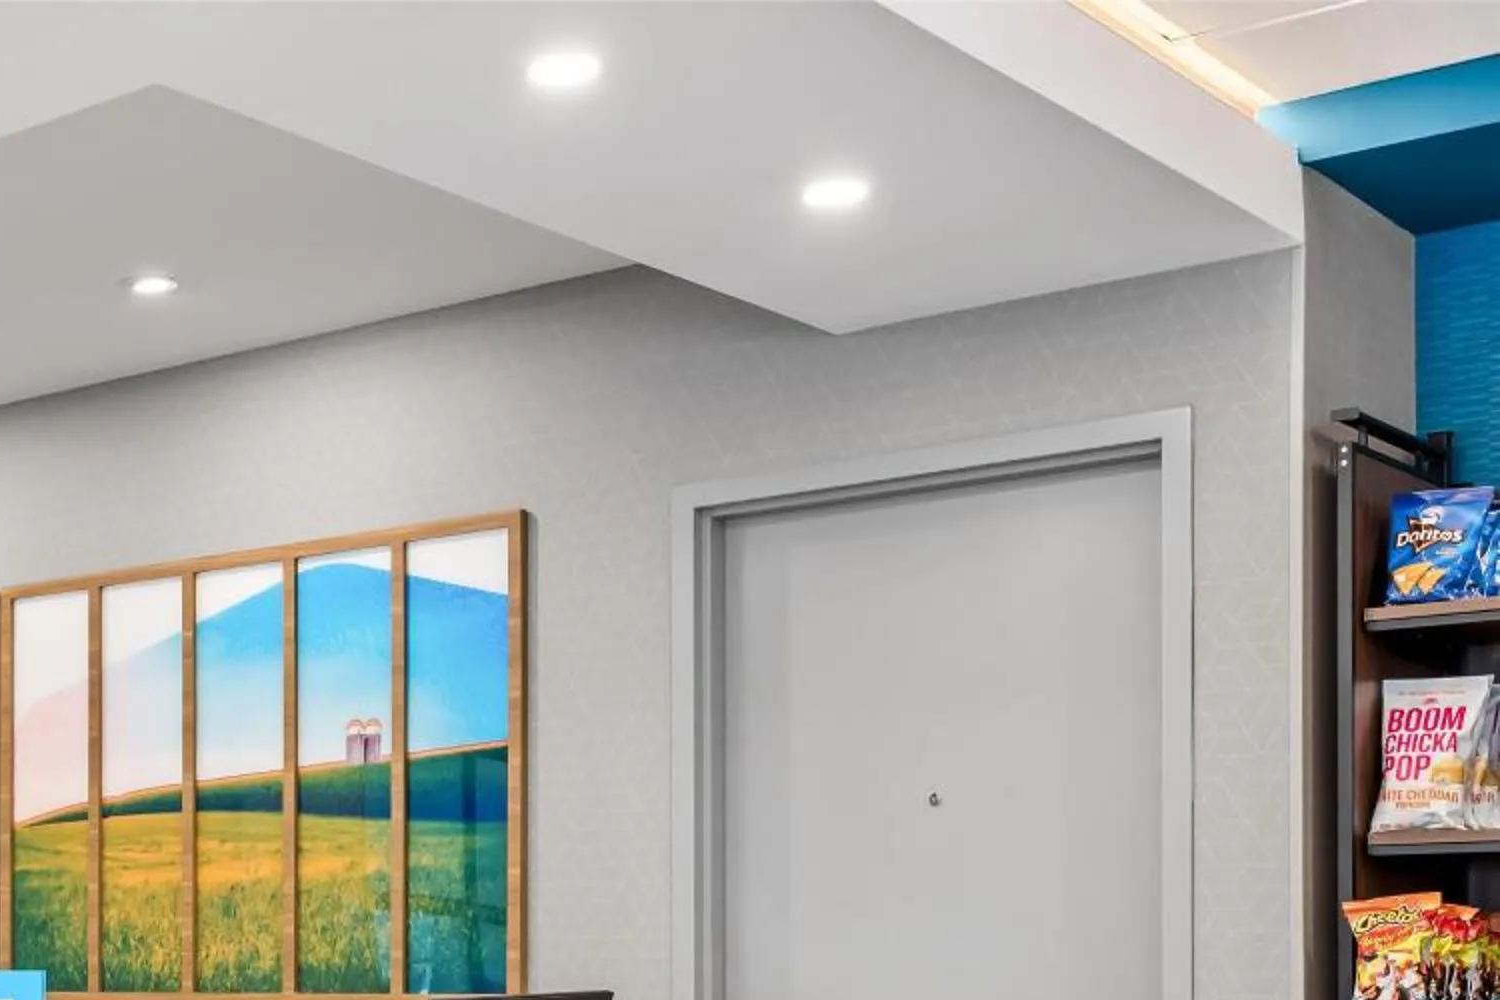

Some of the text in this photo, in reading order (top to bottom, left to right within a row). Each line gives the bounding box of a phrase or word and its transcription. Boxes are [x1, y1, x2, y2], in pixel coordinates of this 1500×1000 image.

[1396, 528, 1463, 548] Doritos
[1387, 705, 1467, 733] BOOM
[1384, 731, 1458, 754] CHICKA
[1381, 755, 1431, 782] POP
